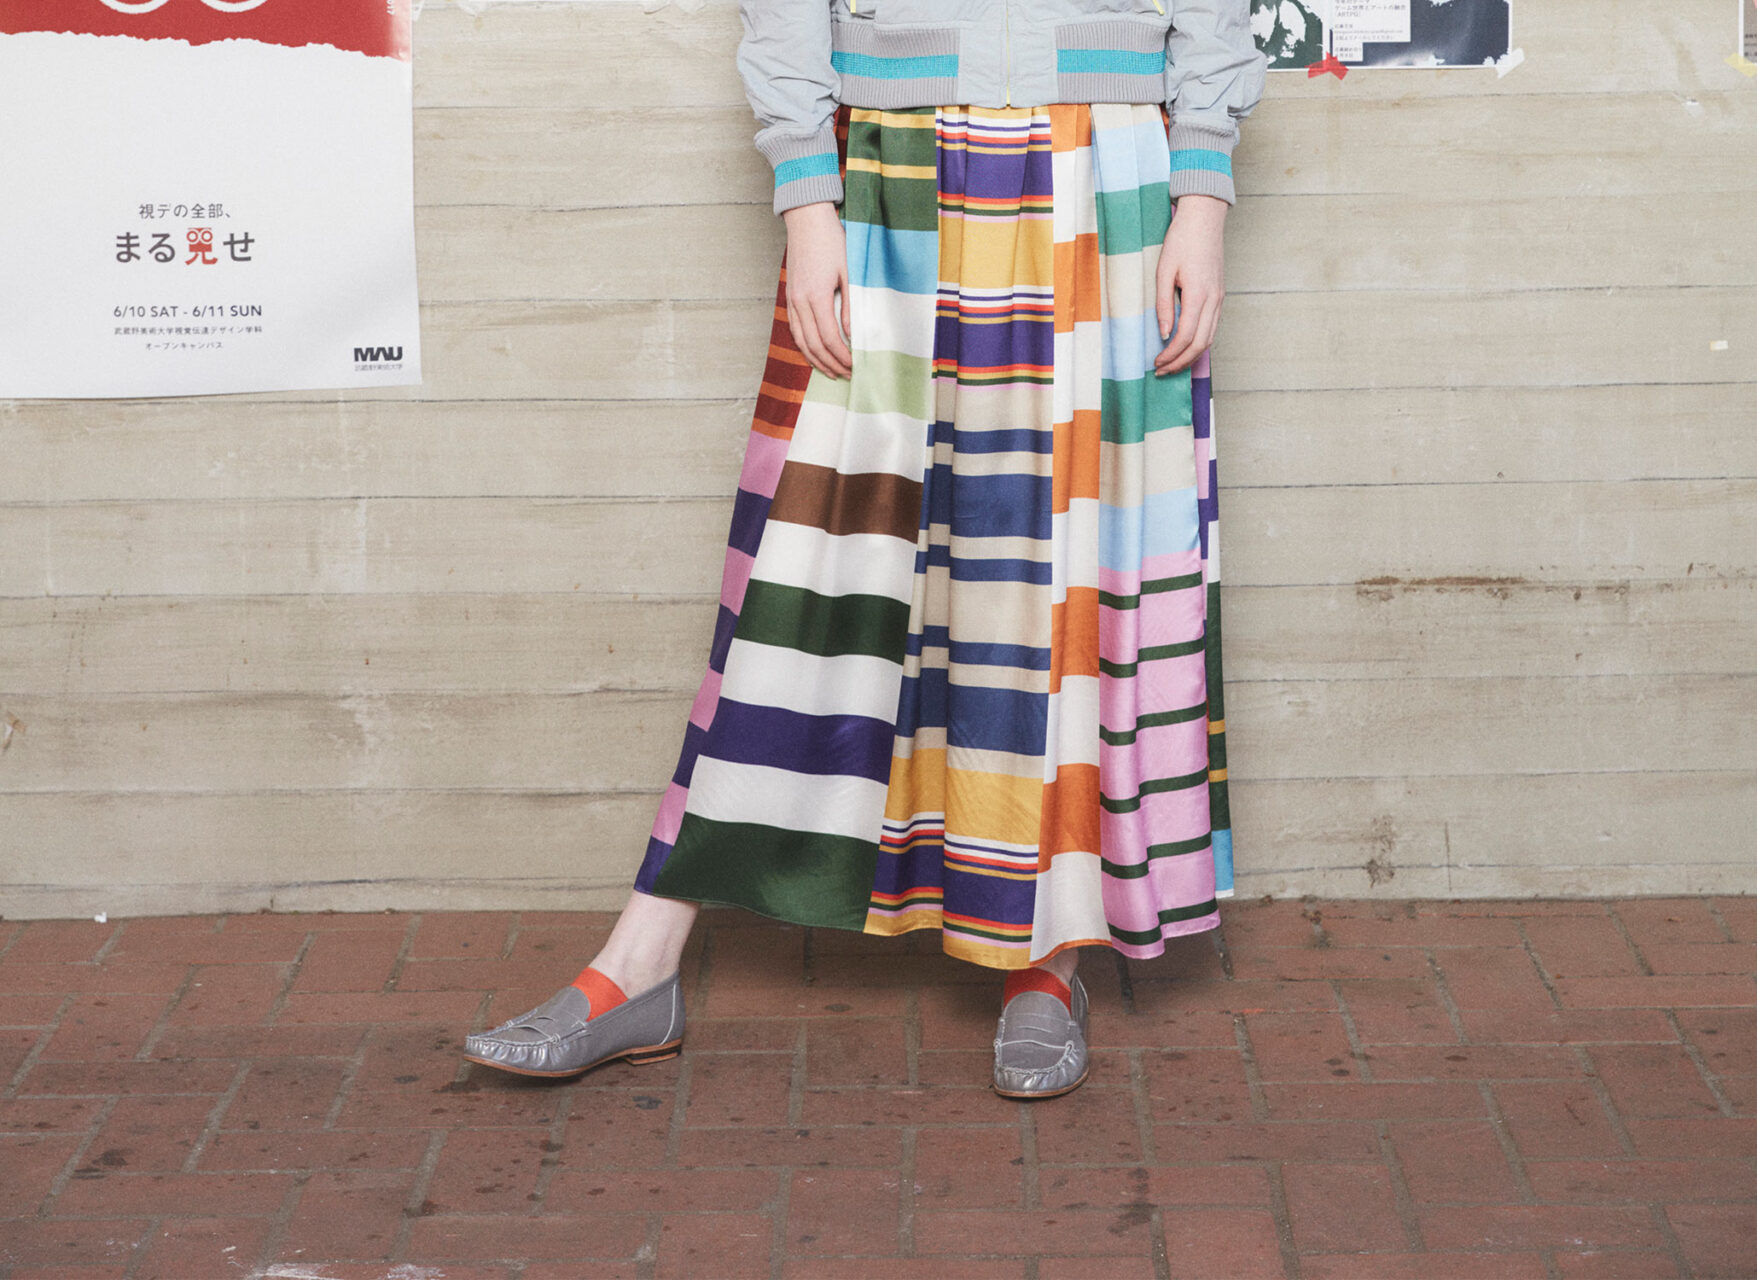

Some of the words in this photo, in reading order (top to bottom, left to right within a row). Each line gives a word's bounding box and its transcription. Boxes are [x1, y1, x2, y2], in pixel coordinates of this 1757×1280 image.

[138, 202, 231, 220] 視デの全部、
[113, 305, 146, 318] 6/10
[150, 305, 179, 318] SAT
[192, 305, 225, 318] 6/11
[230, 304, 263, 317] SUN
[114, 325, 263, 336] 武蔵野美術大学視覚伝達デザイン学科
[145, 341, 224, 351] オープンキャンパス
[353, 346, 403, 362] MAU
